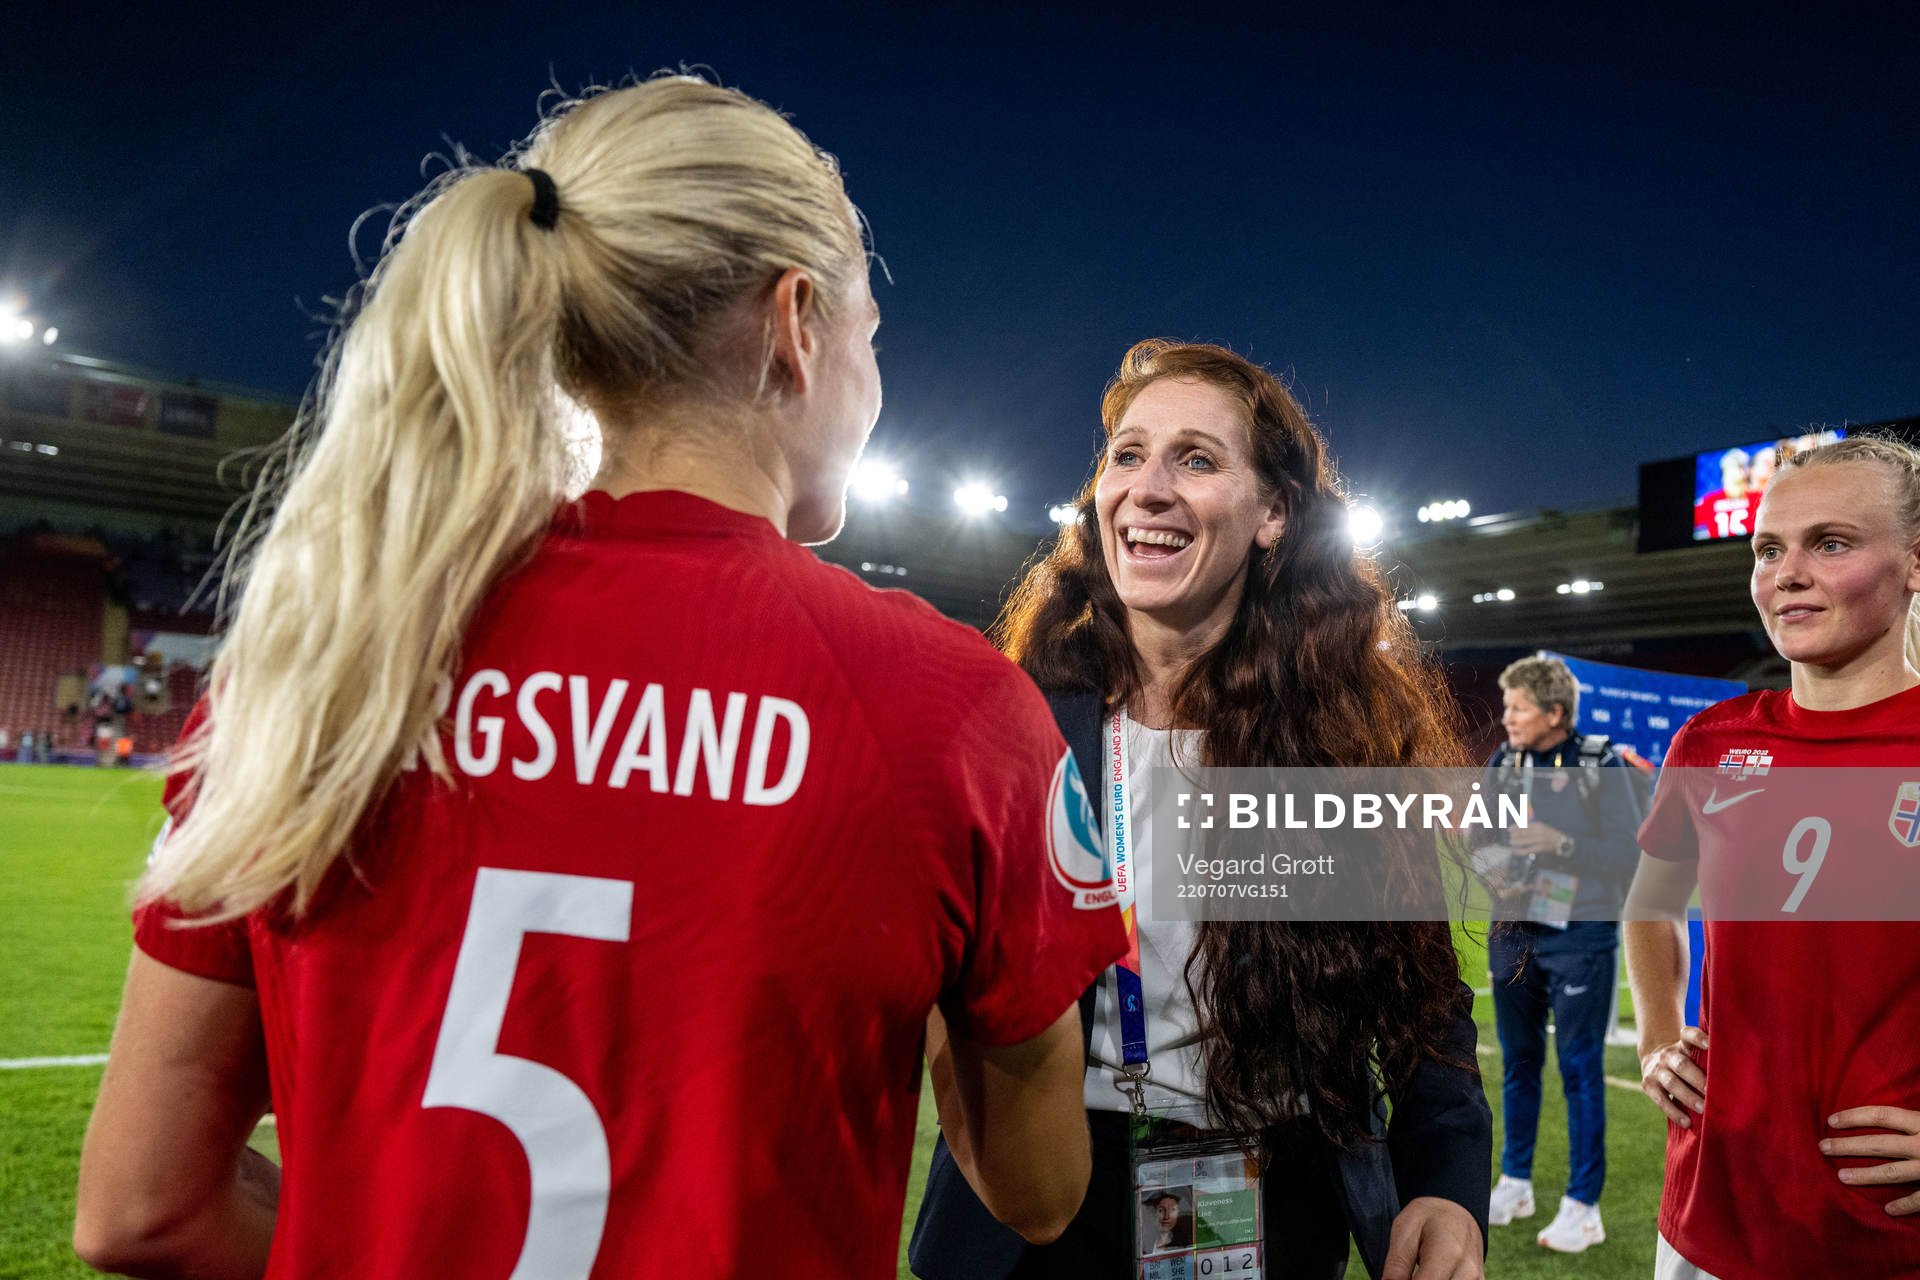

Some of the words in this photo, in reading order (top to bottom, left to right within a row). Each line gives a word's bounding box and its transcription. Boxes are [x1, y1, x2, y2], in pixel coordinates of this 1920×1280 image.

[1112, 735, 1122, 782] ENGLAND
[1113, 783, 1124, 813] EURO
[1115, 813, 1125, 863] WOMEN'S
[1117, 864, 1127, 893] UEFA
[1781, 816, 1832, 913] 9
[421, 866, 634, 1280] 5
